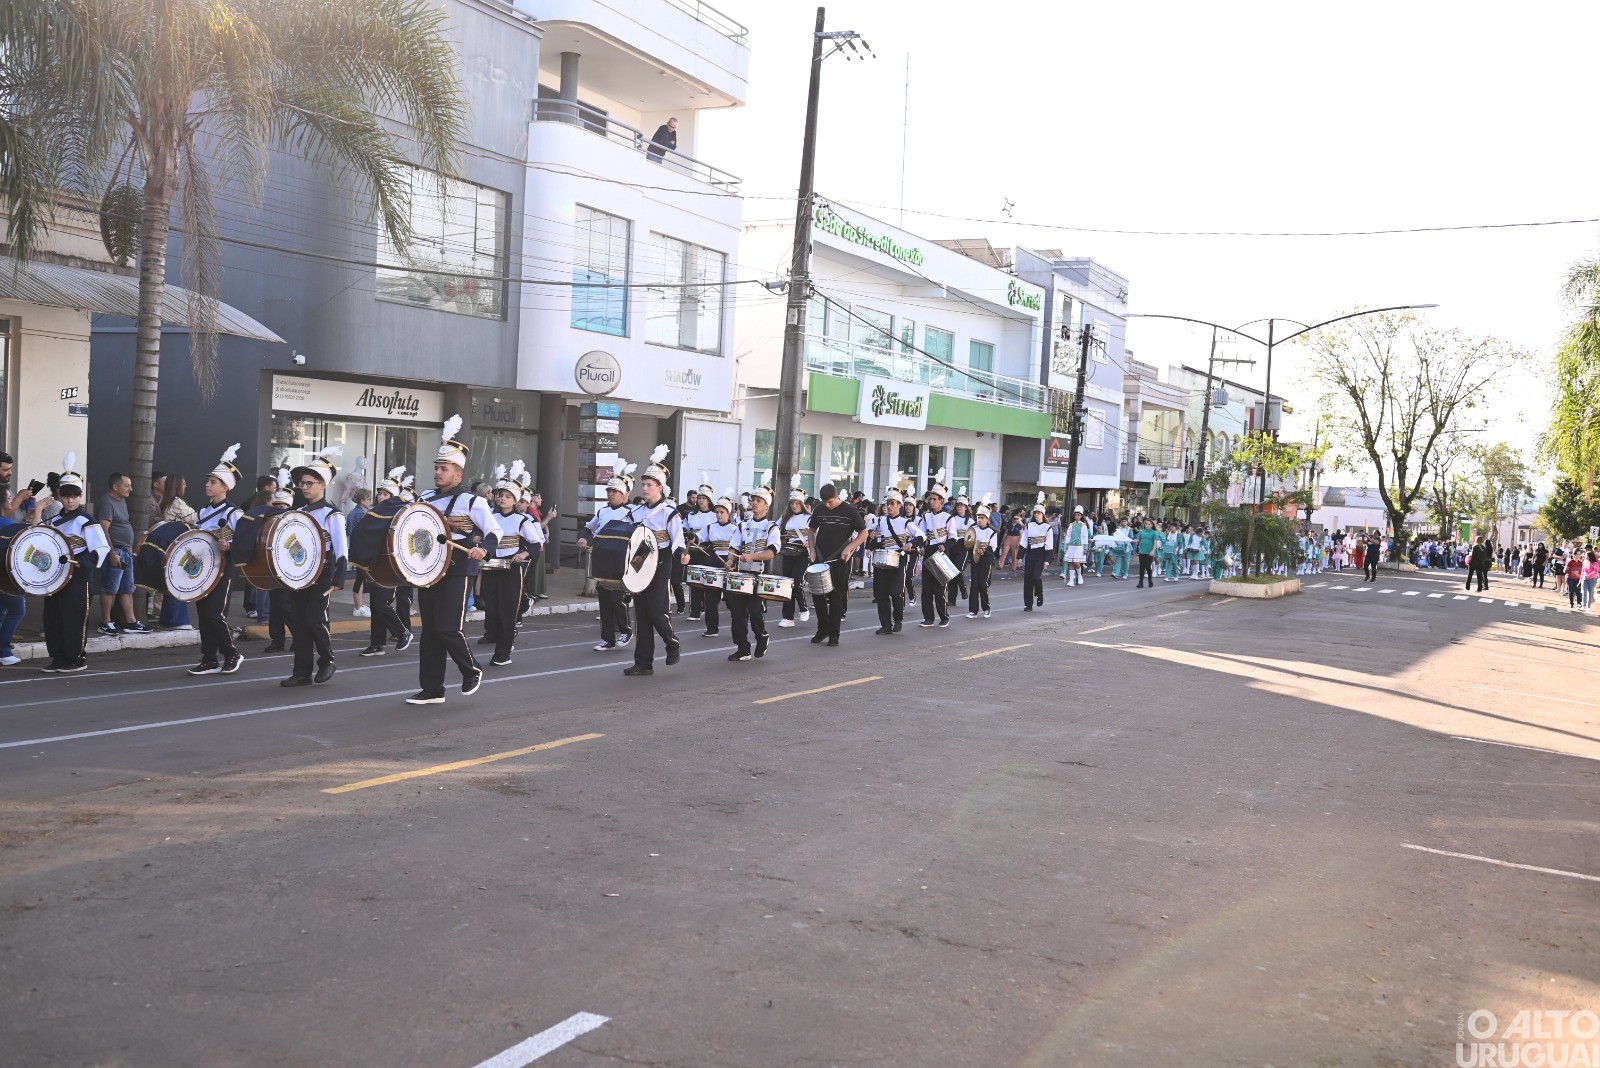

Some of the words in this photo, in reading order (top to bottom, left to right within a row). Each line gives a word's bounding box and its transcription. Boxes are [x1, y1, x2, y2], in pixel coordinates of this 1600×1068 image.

[815, 206, 843, 236] Sede
[855, 226, 890, 253] Sicredi
[1016, 286, 1041, 311] Sicredi
[579, 368, 615, 383] Plurall
[664, 368, 702, 386] SHADOW
[483, 404, 516, 424] Plurall
[885, 391, 924, 418] Sicredi
